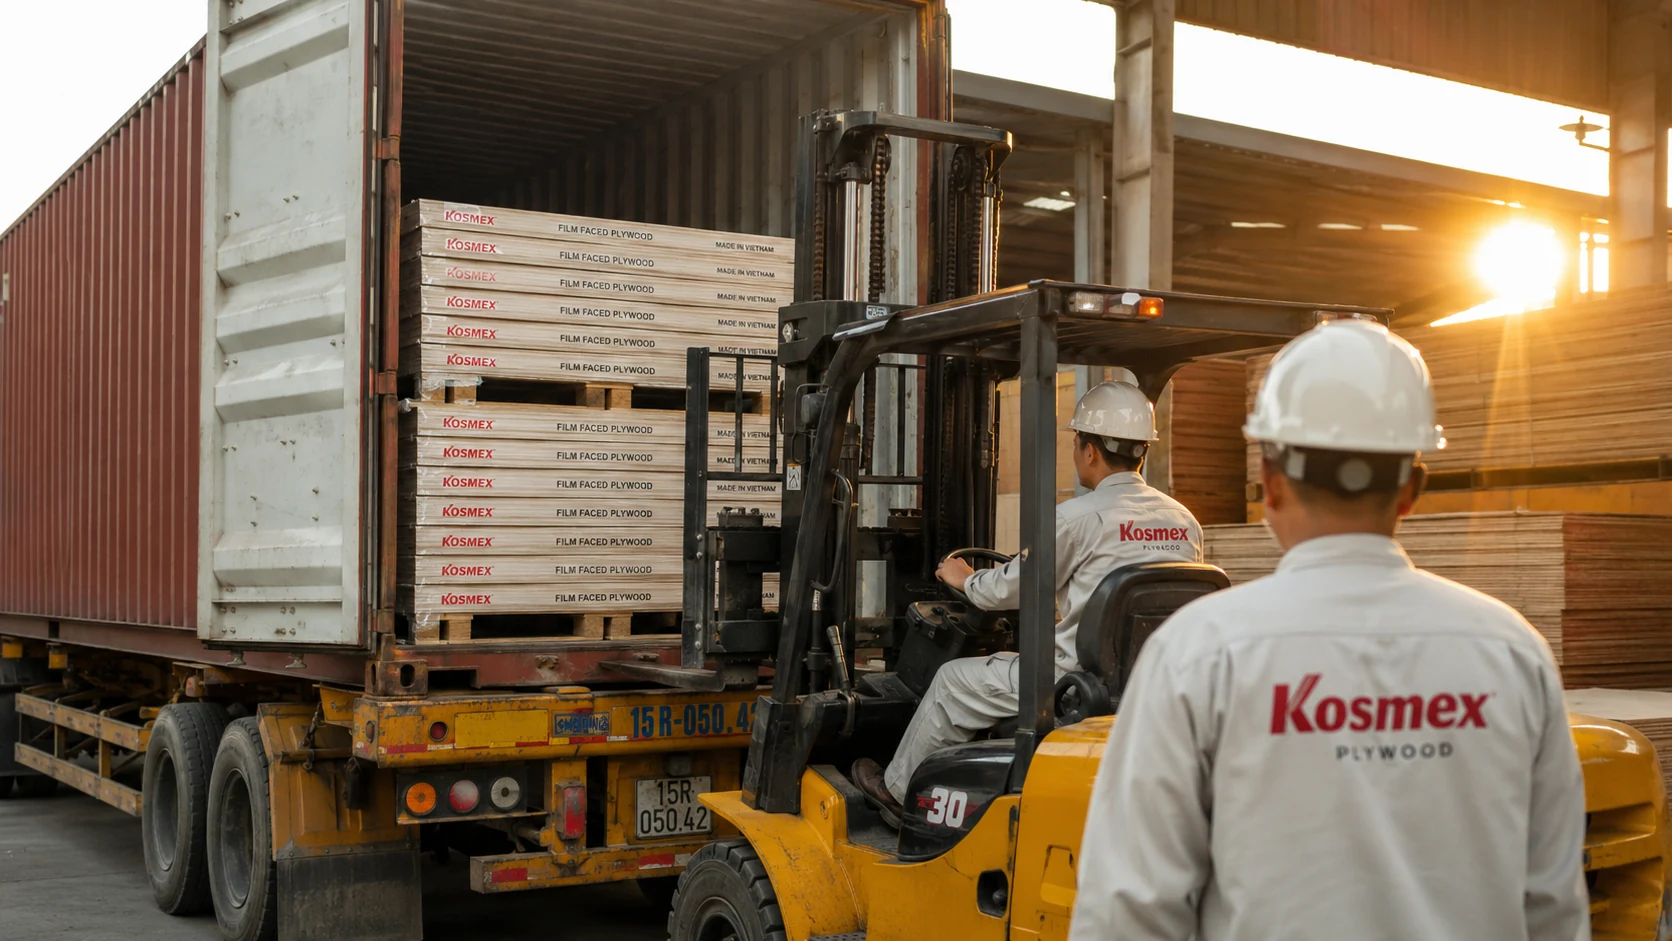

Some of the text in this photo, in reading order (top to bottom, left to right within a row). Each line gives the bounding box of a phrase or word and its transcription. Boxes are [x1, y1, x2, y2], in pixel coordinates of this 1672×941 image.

[445, 210, 495, 225] KOSMEX
[559, 224, 653, 240] FILM FACED PLYWOOD
[447, 238, 496, 253] KOSMEX
[716, 241, 735, 250] MADE
[745, 245, 774, 253] VIETNAM
[560, 252, 654, 267] FILM FACED PLYWOOD
[447, 267, 496, 281] KOSMEX
[717, 267, 736, 275] MADE
[746, 270, 775, 278] VIETNAM
[560, 280, 654, 293] FILM FACED PLYWOOD
[447, 296, 496, 309] KOSMEX
[717, 293, 737, 301] MADE
[560, 307, 655, 320] FILM FACED PLYWOOD
[718, 319, 737, 327] MADE
[447, 325, 496, 339] KOSMEX
[560, 335, 655, 347] FILM FACED PLYWOOD
[447, 354, 496, 367] KOSMEX
[583, 364, 611, 372] FACED
[614, 366, 655, 374] PLYWOOD
[443, 416, 493, 429] KOSMEX
[557, 423, 652, 434] FILM FACED PLYWOOD
[444, 446, 493, 458] KOSMEX
[557, 452, 577, 460] FILM
[580, 453, 608, 461] FACED
[443, 475, 493, 488] KOSMEX
[580, 481, 608, 489] FACED
[611, 482, 652, 490] PLYWOOD
[443, 504, 492, 517] KOSMEX
[579, 509, 607, 517] FACED
[1119, 519, 1189, 542] Kosmex
[442, 535, 492, 547] KOSMEX
[556, 538, 652, 546] FILM FACED PLYWOOD
[442, 564, 492, 576] KOSMEX
[441, 593, 491, 605] KOSMEX
[555, 594, 576, 602] FILM
[610, 593, 651, 601] PLYWOOD
[1269, 673, 1489, 735] Kosmex
[1335, 742, 1454, 761] PLYWOOD
[927, 787, 968, 828] 30
[640, 807, 708, 834] 050.42
